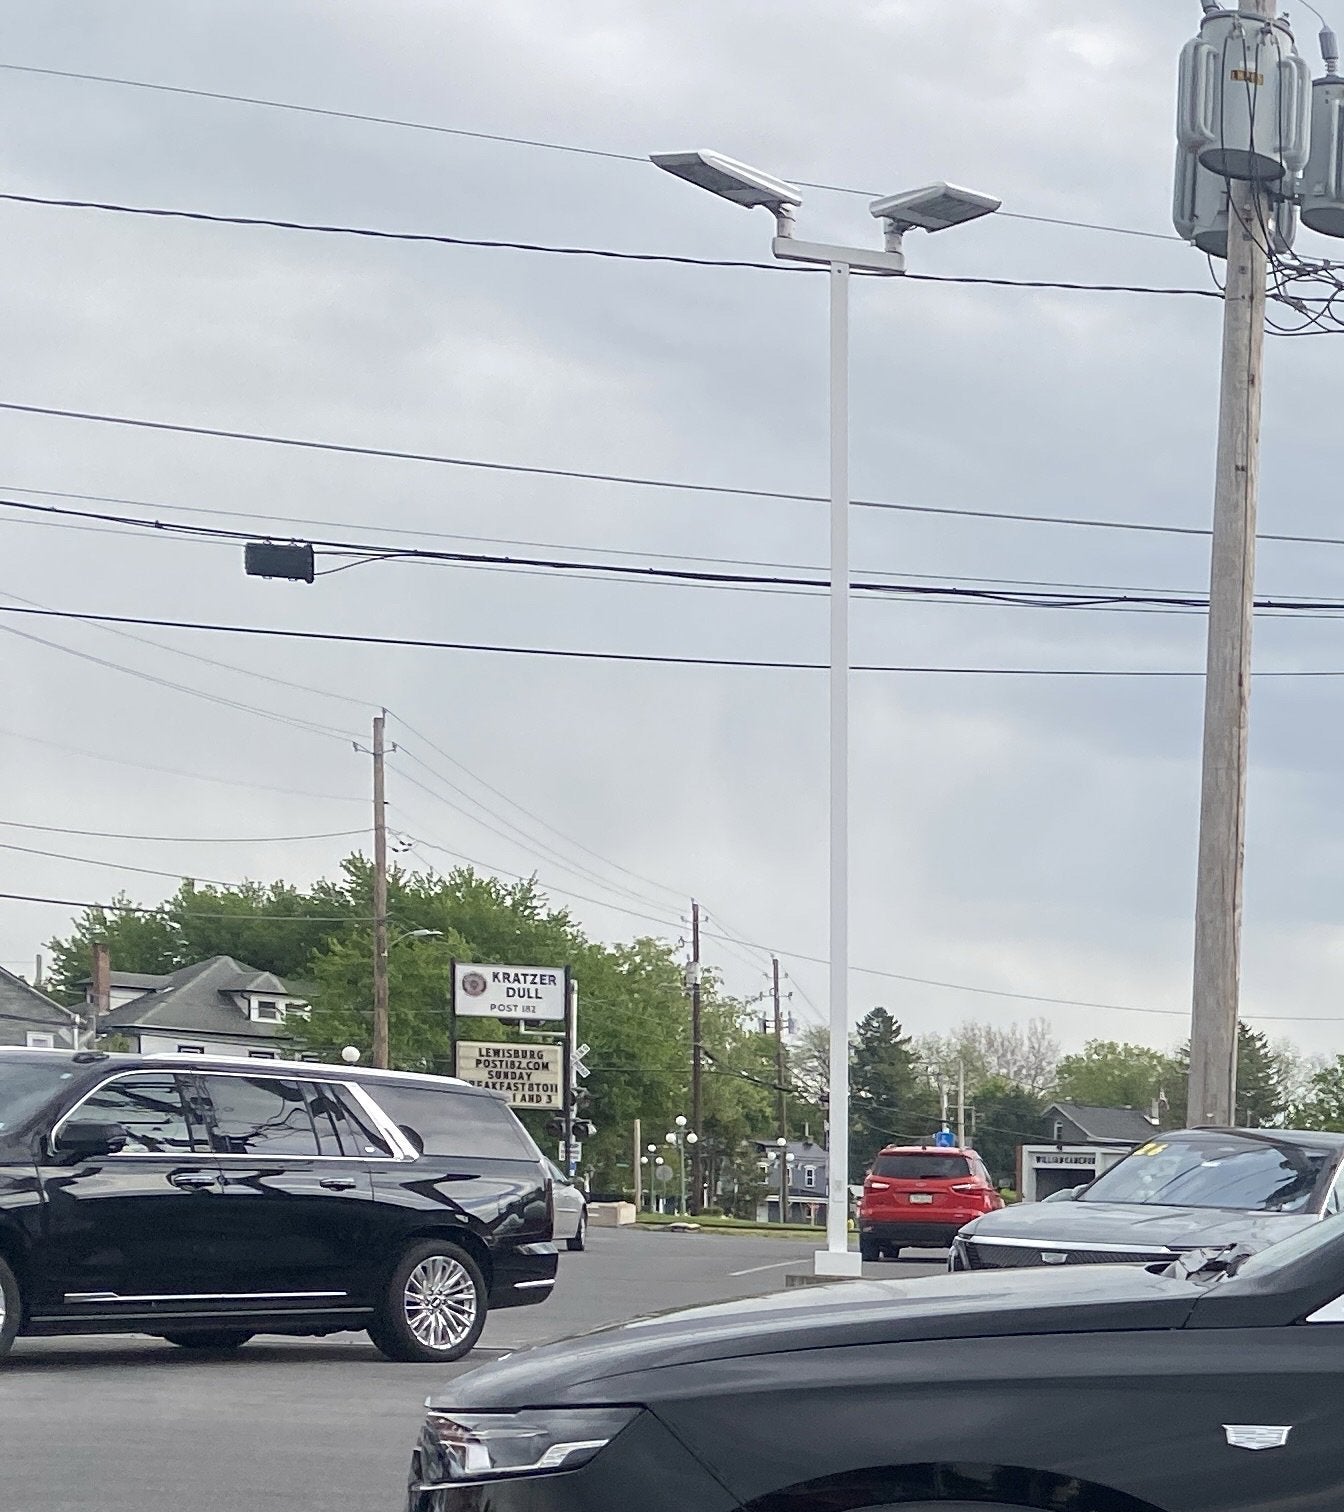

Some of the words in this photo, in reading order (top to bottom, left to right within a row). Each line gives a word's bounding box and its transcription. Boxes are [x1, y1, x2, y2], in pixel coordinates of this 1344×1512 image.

[491, 971, 557, 986] KRATZER
[506, 987, 543, 999] DULL
[490, 1003, 518, 1012] POST
[522, 1005, 536, 1013] 182
[478, 1047, 544, 1059] LEWISBURG
[475, 1059, 550, 1071] POST182.COM
[487, 1070, 532, 1081] SUNDAY
[520, 1094, 542, 1103] AND
[546, 1095, 553, 1104] 3
